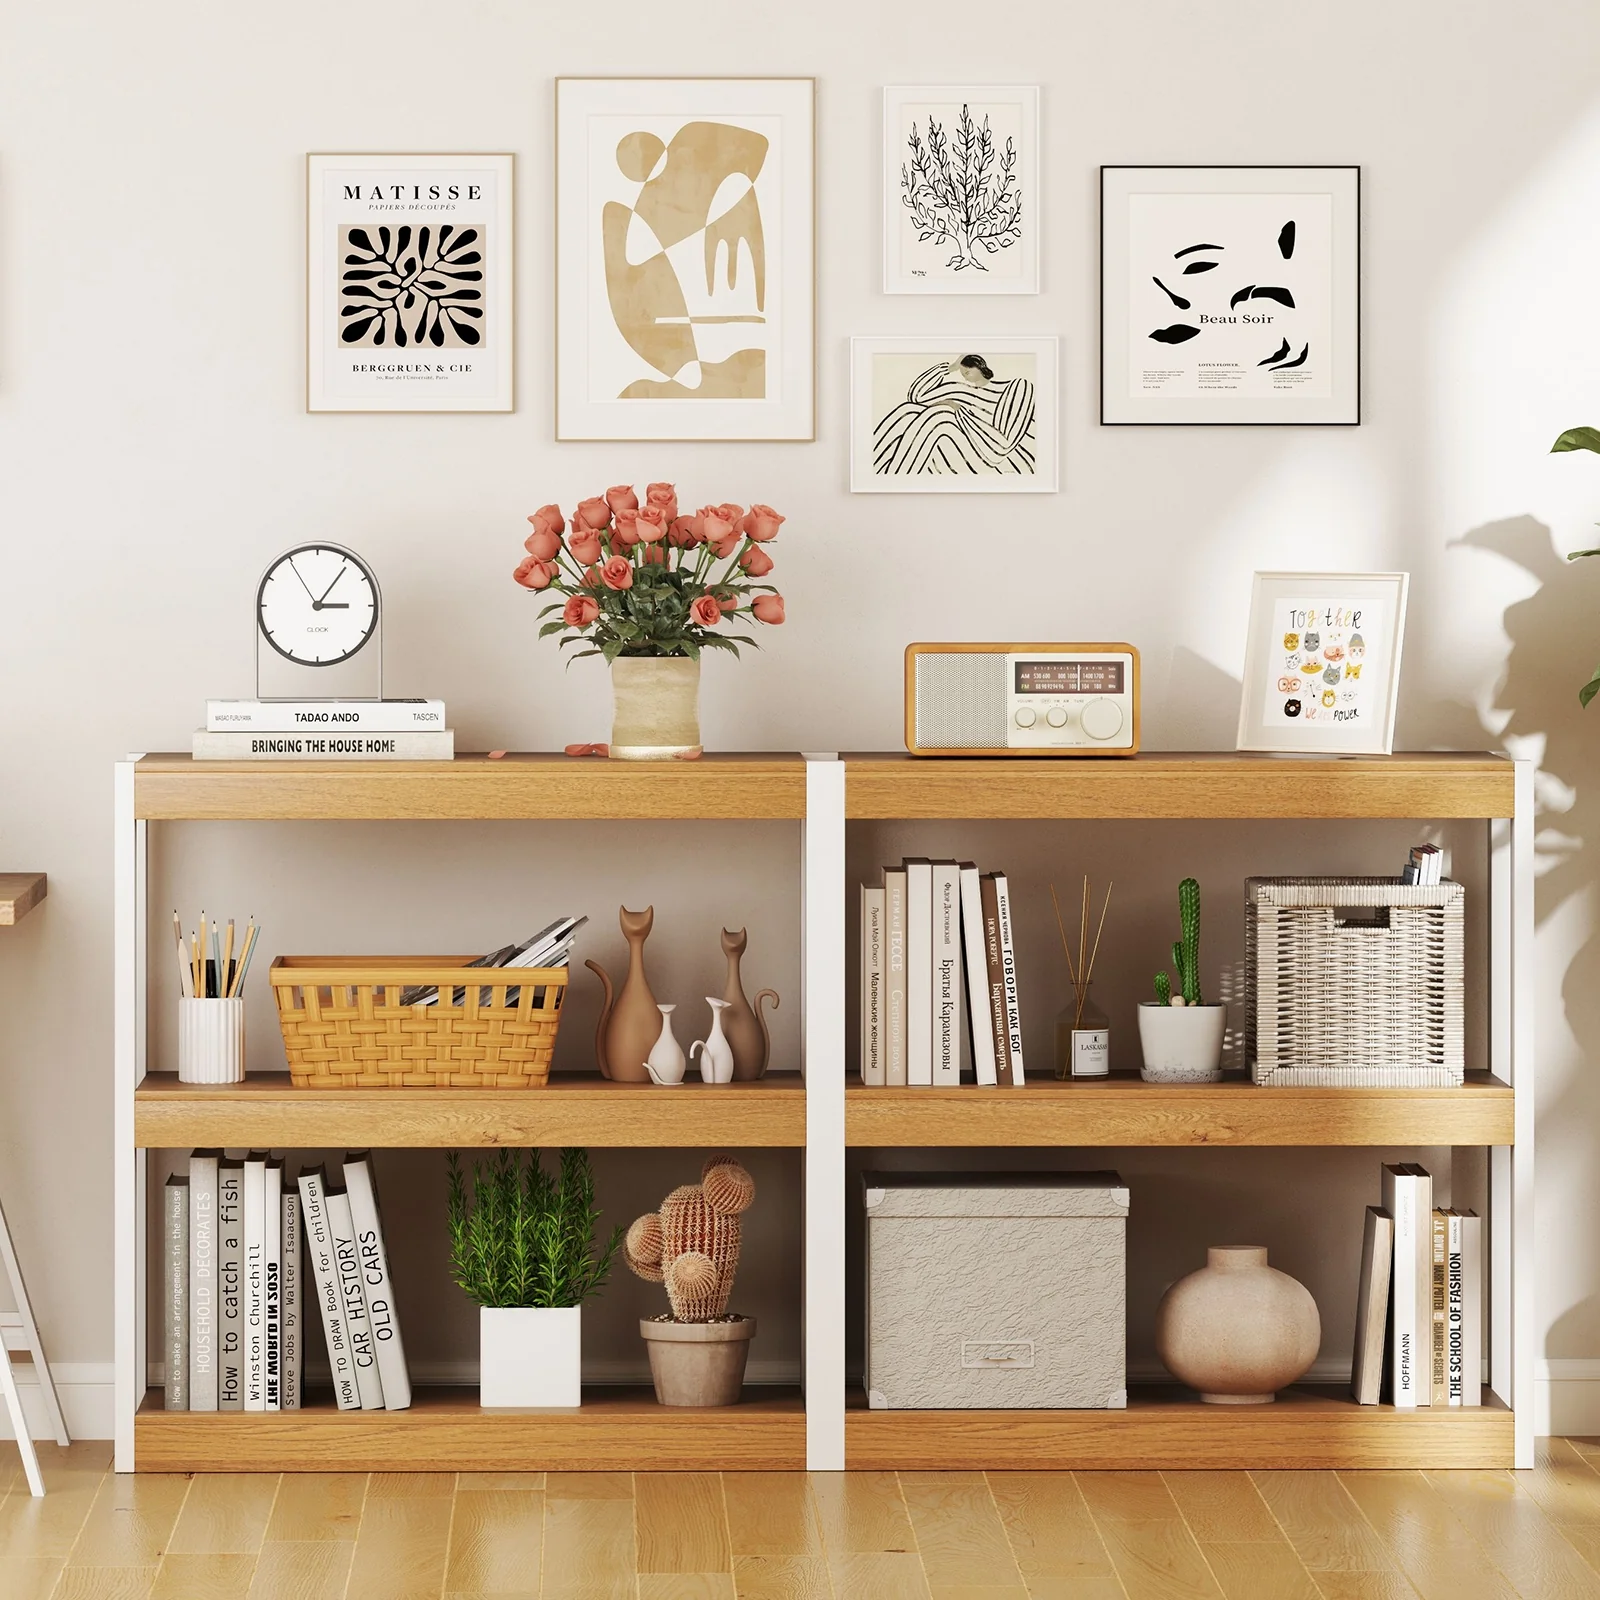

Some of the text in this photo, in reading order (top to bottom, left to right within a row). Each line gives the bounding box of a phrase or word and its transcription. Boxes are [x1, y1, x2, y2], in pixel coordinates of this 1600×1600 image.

[344, 185, 481, 200] MATISSE
[1199, 314, 1274, 324] Beau Soir
[352, 364, 472, 372] BERGGRUEN & CIE
[295, 713, 360, 722] TADAO ANDO
[413, 713, 439, 721] TASCEN
[252, 740, 395, 753] BRINGING THE HOUSE HOME
[871, 906, 879, 927] Луиза
[872, 928, 880, 943] Мэй
[892, 931, 902, 972] ГЕССЕ
[939, 959, 954, 1070] Братья Карамазовы
[1003, 950, 1021, 1054] ГОВОРИ КАК БОГ
[870, 972, 880, 1069] Маленькие женщины
[991, 983, 1006, 1070] Бархатная смерть
[308, 1181, 325, 1242] children
[320, 1251, 330, 1273] for
[1434, 1234, 1444, 1262] ROWLING
[197, 1192, 210, 1373] HOUSEHOLD DECORATES
[221, 1179, 238, 1401] How to catch a fish
[359, 1230, 393, 1341] OLD CARS
[1434, 1265, 1444, 1285] HARRY
[172, 1191, 183, 1403] How to make an arrangement in the house
[285, 1196, 296, 1406] Steve Jobs by Walter Isaacson
[336, 1237, 374, 1367] CAR HISTORY
[1434, 1287, 1444, 1310] POTTER
[250, 1244, 260, 1400] Winston Churchill
[332, 1319, 344, 1350] DRAW
[1433, 1322, 1444, 1351] CHAMBER
[1450, 1252, 1462, 1399] THE SCHOOL OF FASHION
[338, 1357, 347, 1373] TO
[1402, 1333, 1410, 1390] HOFFMANN
[1433, 1358, 1444, 1384] SECRETS
[343, 1381, 352, 1404] HOW
